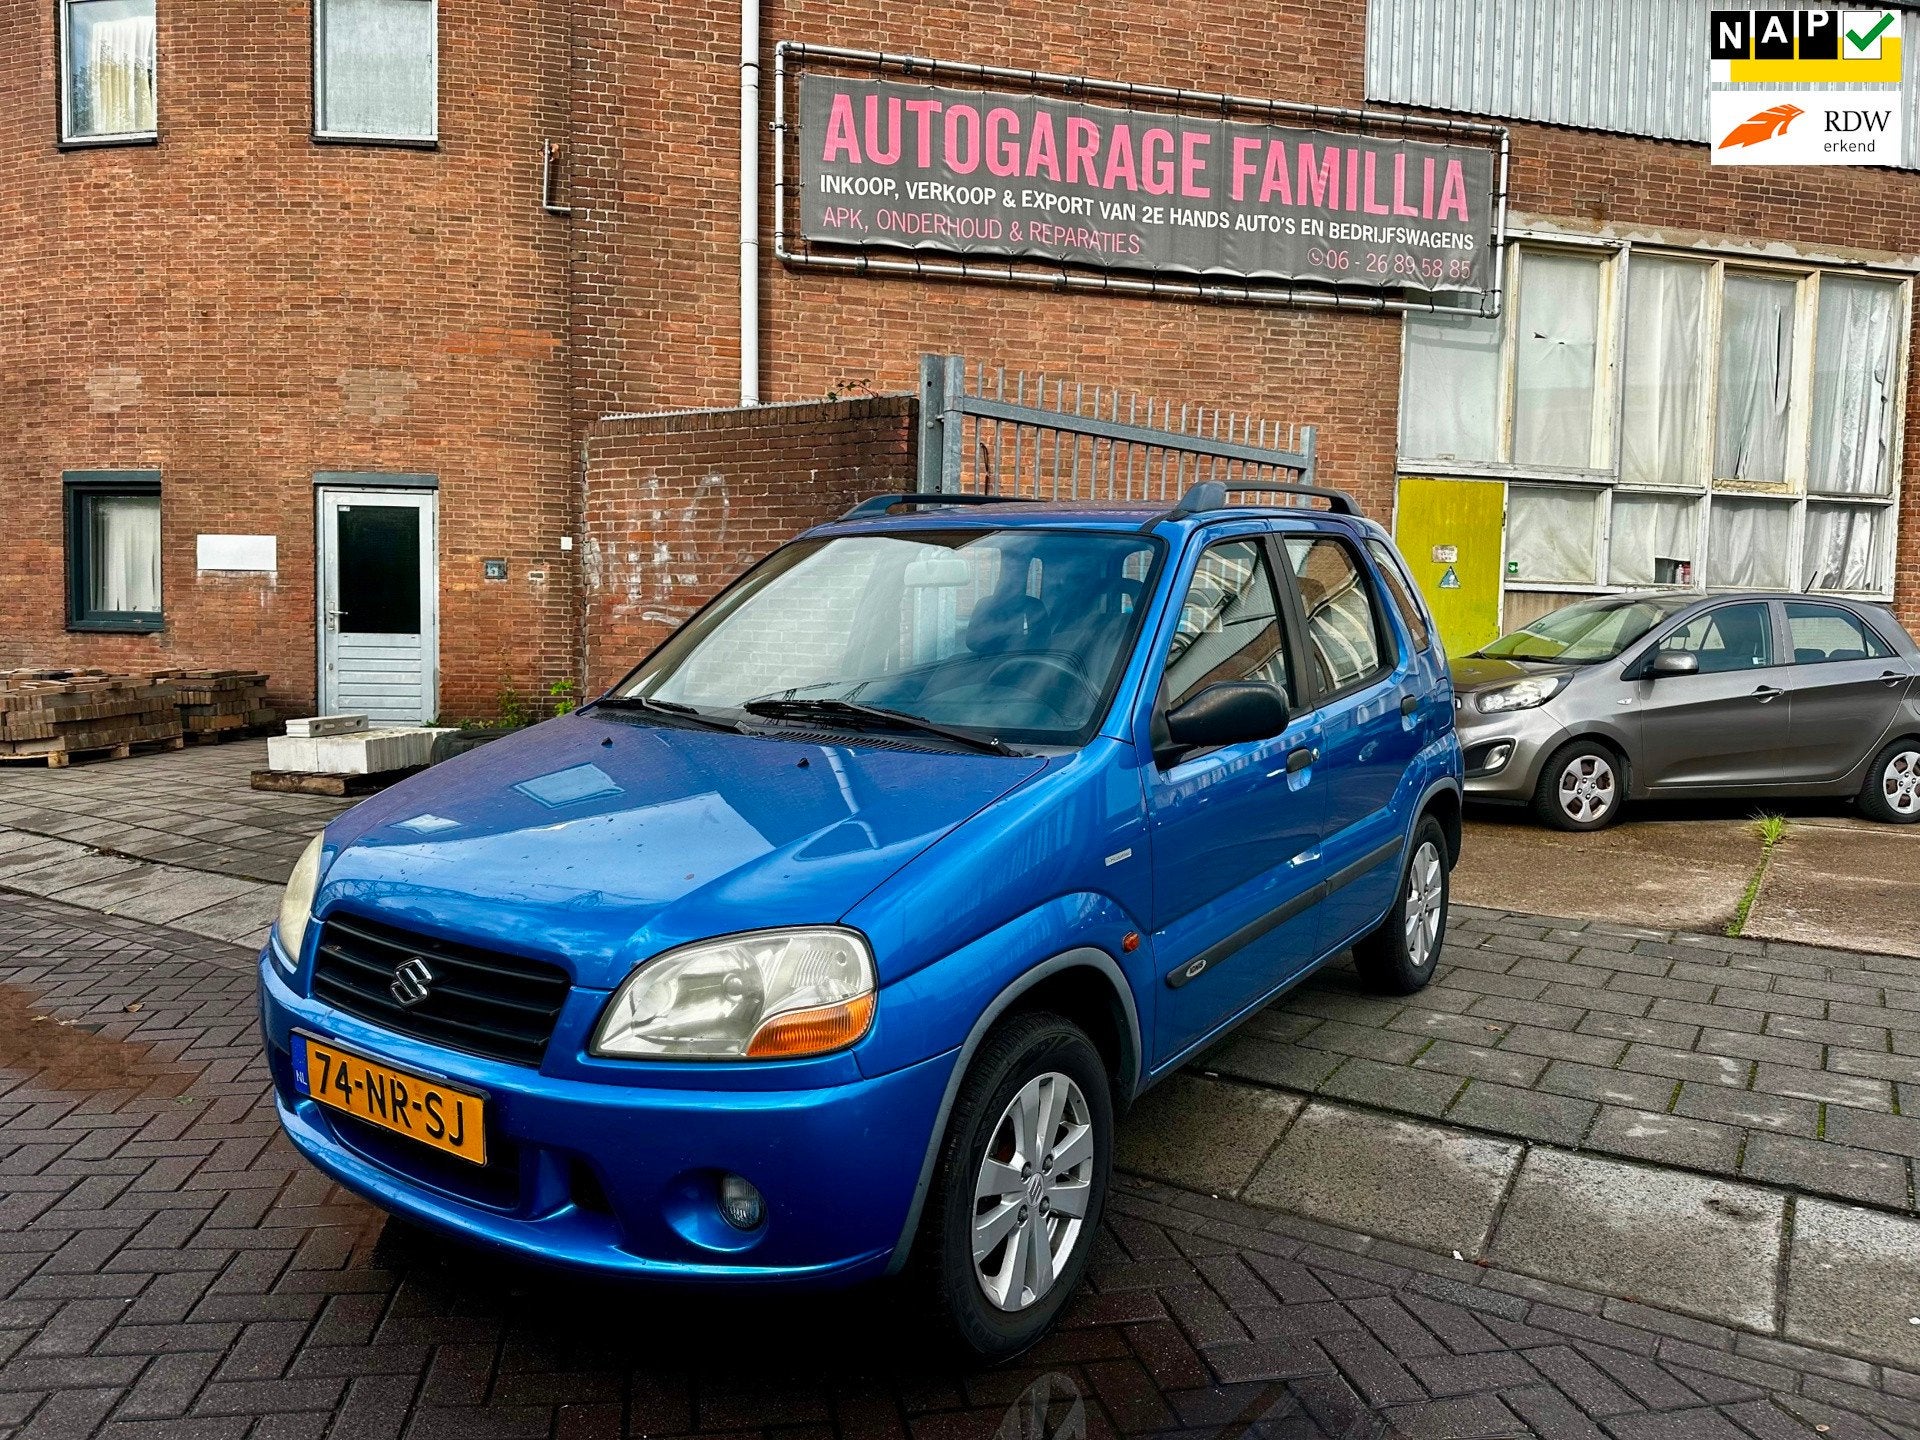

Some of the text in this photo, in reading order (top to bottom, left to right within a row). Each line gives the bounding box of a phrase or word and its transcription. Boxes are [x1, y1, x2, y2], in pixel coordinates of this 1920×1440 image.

[822, 93, 1469, 222] AUTOGARAGE FAMILLIA
[820, 174, 1474, 251] INKOOP, VERKOOP & EXPORT VAN 2E HANDS AUTO'S EN BEDRIJFSWAGENS
[822, 206, 1141, 254] APK, ONDERHOUD & REPARATIES
[1326, 250, 1350, 270] 06
[1366, 253, 1389, 274] 26
[1394, 254, 1415, 275] 89
[1421, 258, 1443, 278] 58
[1449, 259, 1471, 279] 85
[295, 1069, 308, 1086] NL
[314, 1050, 464, 1147] 74-NR-SJ
